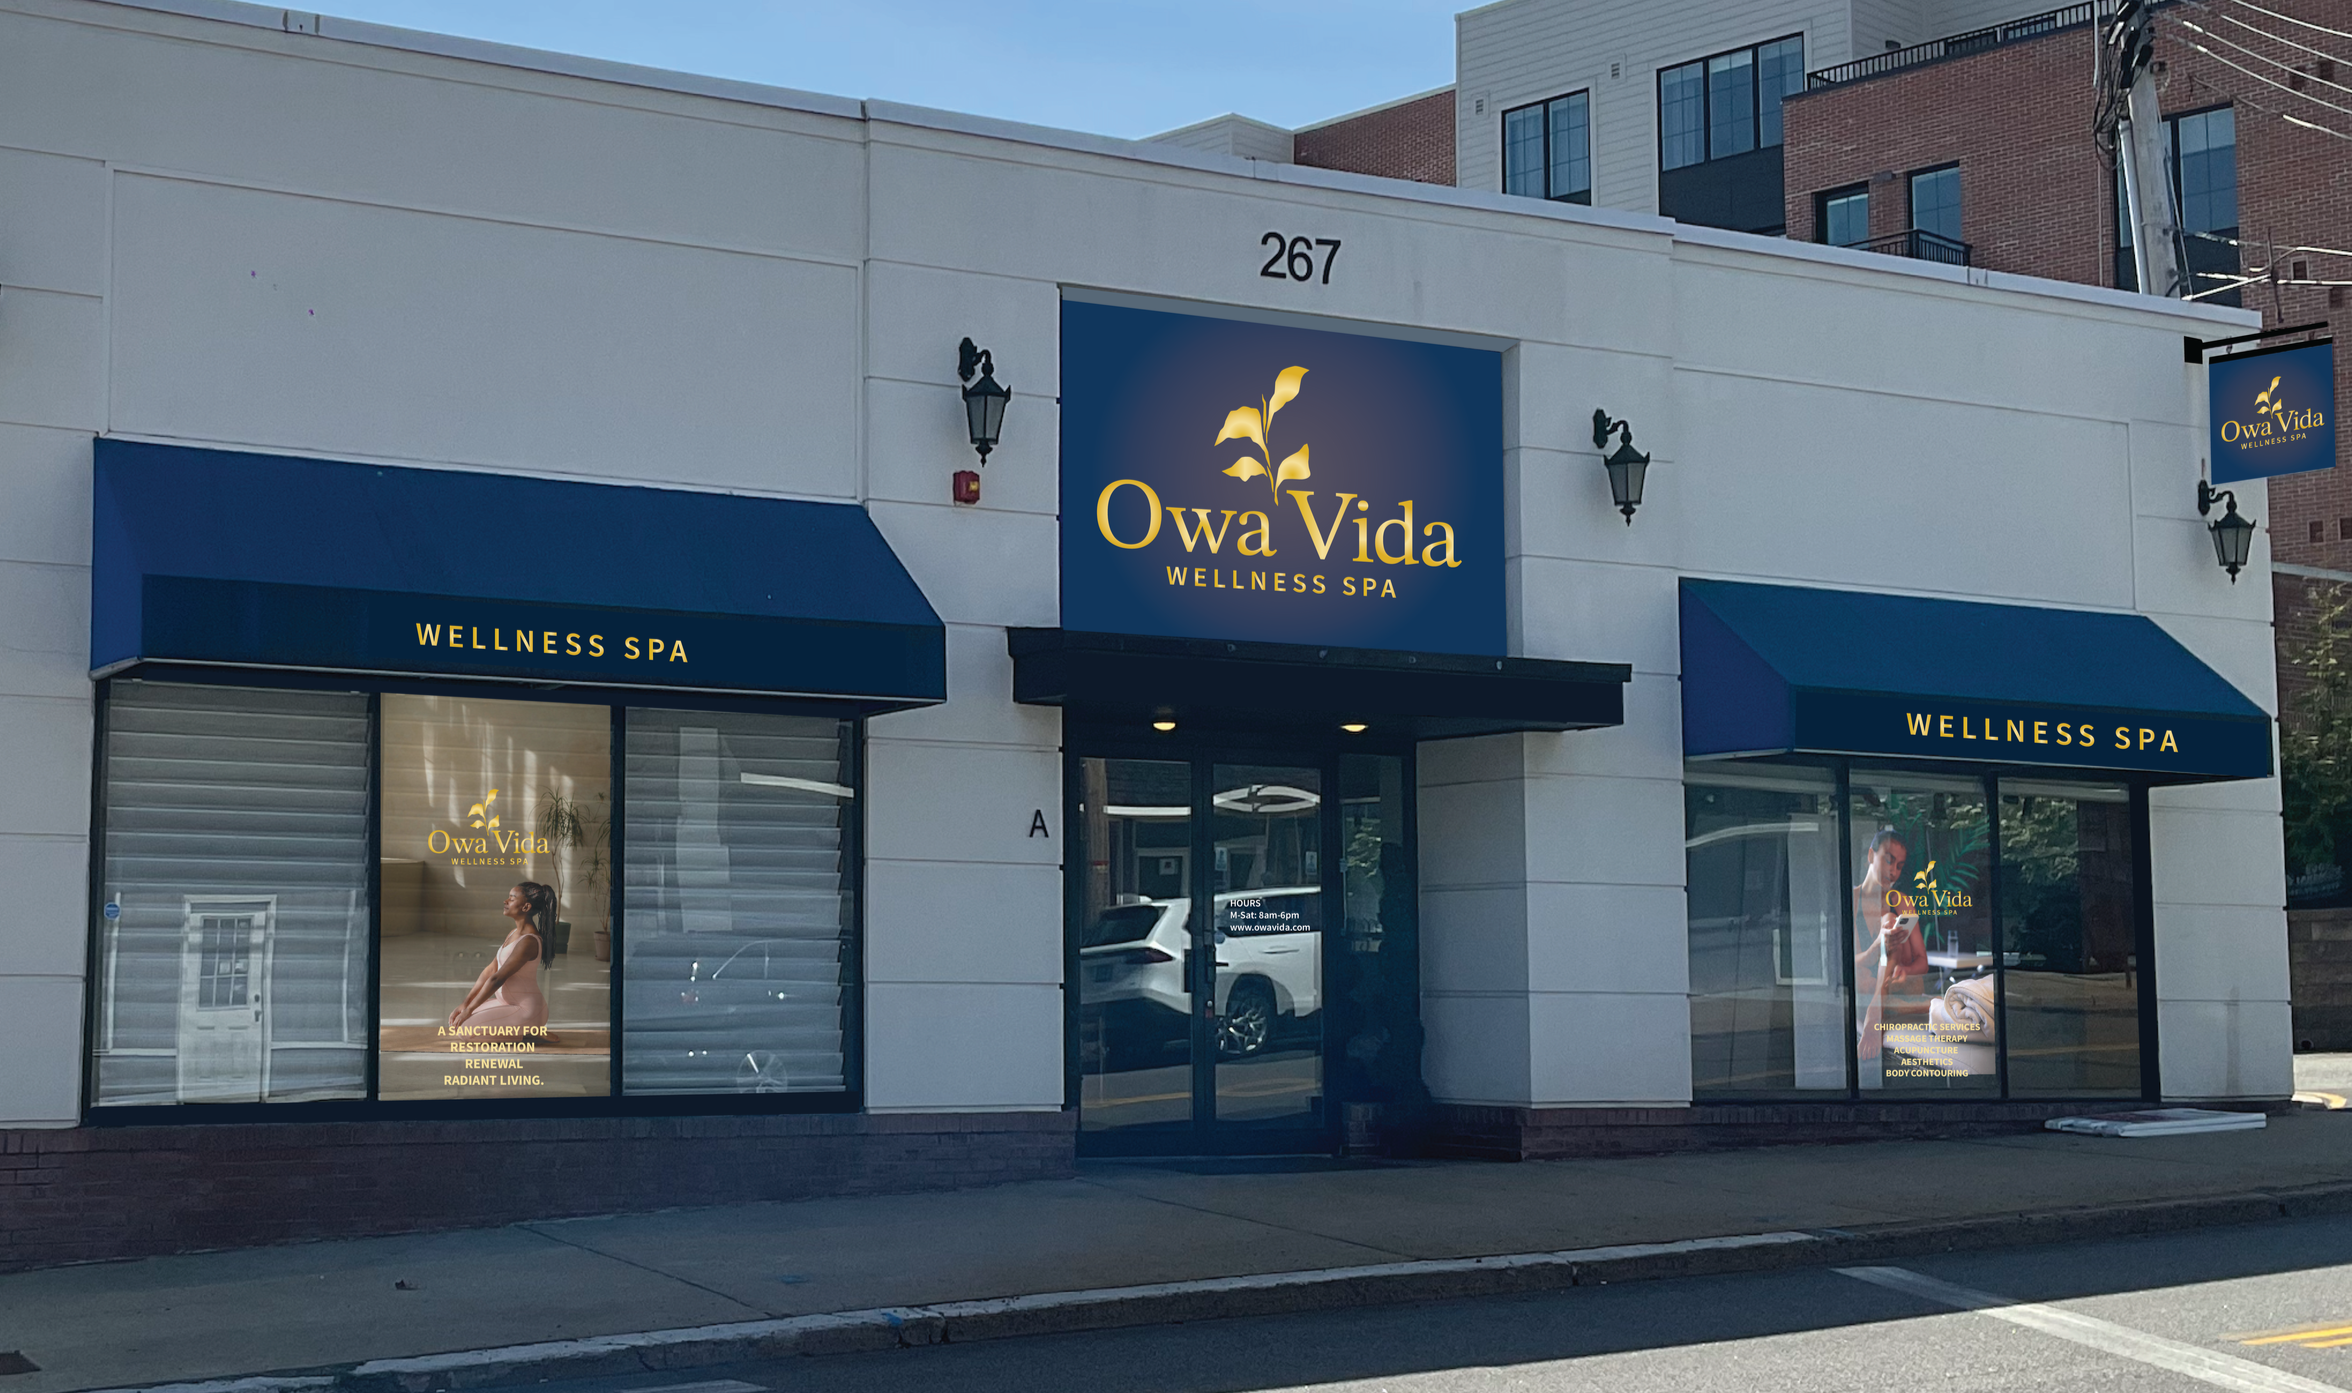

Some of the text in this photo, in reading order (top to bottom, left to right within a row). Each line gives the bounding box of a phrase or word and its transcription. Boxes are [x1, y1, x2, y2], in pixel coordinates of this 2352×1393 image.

[1260, 232, 1342, 285] 267
[2221, 408, 2325, 442] Owa Vida
[2240, 432, 2307, 450] WELLNESS SPA
[1096, 479, 1463, 568] Owa Vida
[1166, 566, 1397, 599] WELLNESS SPA
[416, 622, 688, 663] WELLNESS SPA
[1906, 712, 2179, 753] WELLNESS SPA
[1029, 809, 1049, 838] A
[428, 829, 550, 854] Owa Vida
[451, 857, 529, 866] WELLNESS SPA
[1230, 899, 1261, 908] HOURS
[1885, 889, 1973, 908] Owa Vida
[1230, 911, 1300, 921] M-Sat: 8am-6pm
[1229, 923, 1311, 932] www.owavida.com
[437, 1026, 548, 1036] A SANCTUARY FOR
[1874, 1023, 1981, 1031] CHIROPRACTIC SERVICES
[1886, 1035, 1968, 1043] MASSAGE THERAPY
[450, 1042, 535, 1053] RESTORATION
[1894, 1046, 1958, 1054] ACUPUNCTURE
[465, 1059, 523, 1069] RENEWAL
[1901, 1058, 1953, 1066] AESTHETICS
[1886, 1069, 1969, 1077] BODY CONTOURING
[444, 1075, 544, 1086] RADIANT LIVING.
